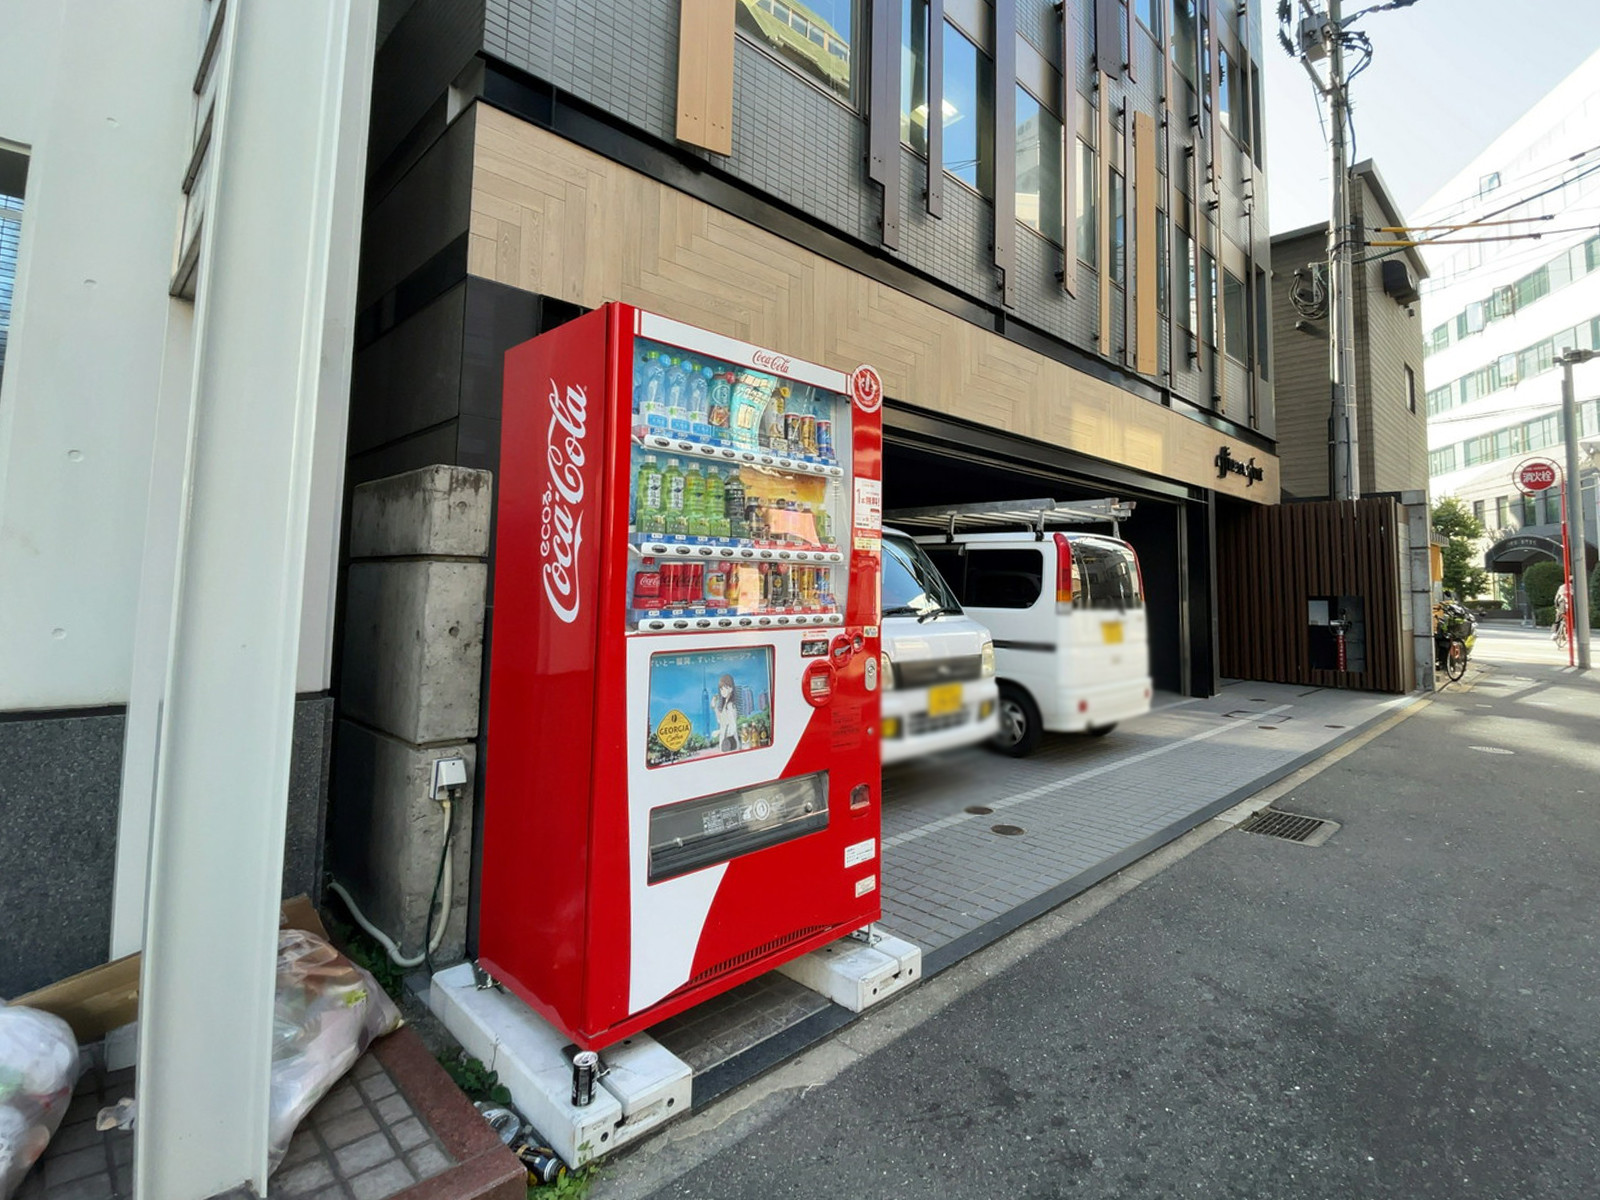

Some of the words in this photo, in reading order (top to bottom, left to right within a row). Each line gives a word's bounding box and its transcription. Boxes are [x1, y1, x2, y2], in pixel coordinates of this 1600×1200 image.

[1522, 470, 1553, 483] 消火栓
[542, 378, 588, 623] Coca-Cola
[659, 724, 690, 736] GEORGIA
